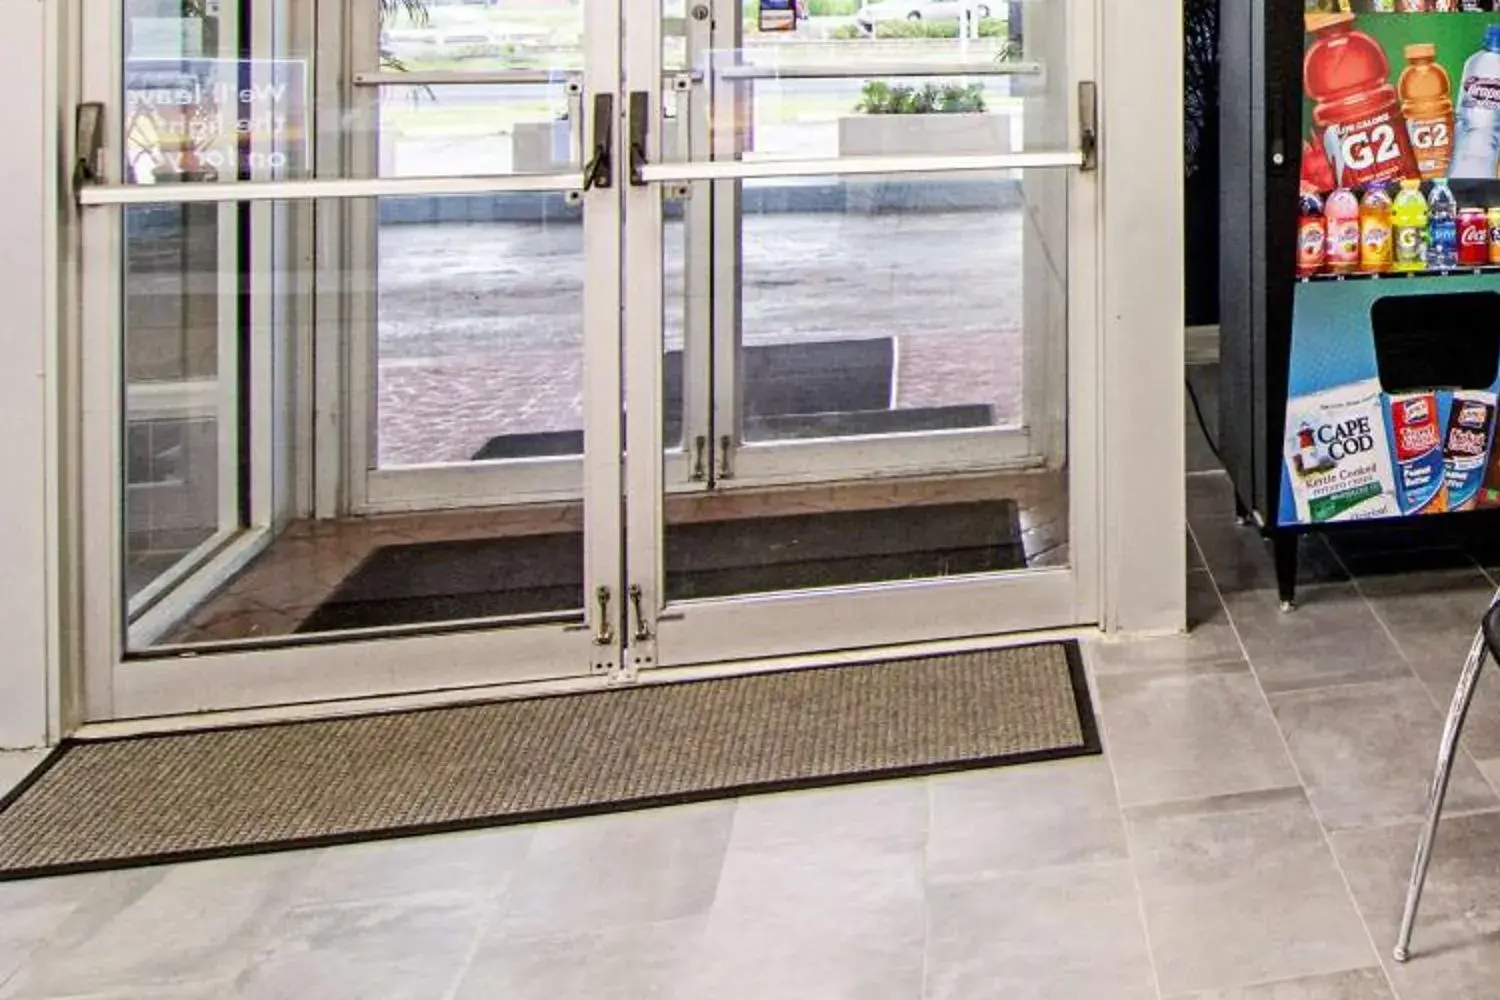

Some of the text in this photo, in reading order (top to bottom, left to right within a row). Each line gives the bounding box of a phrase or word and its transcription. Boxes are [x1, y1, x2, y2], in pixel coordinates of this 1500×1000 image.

[1342, 124, 1400, 169] G2
[1413, 123, 1449, 148] G2
[1317, 416, 1371, 444] CAPE
[1328, 435, 1374, 460] COD
[1339, 463, 1377, 479] Cooked
